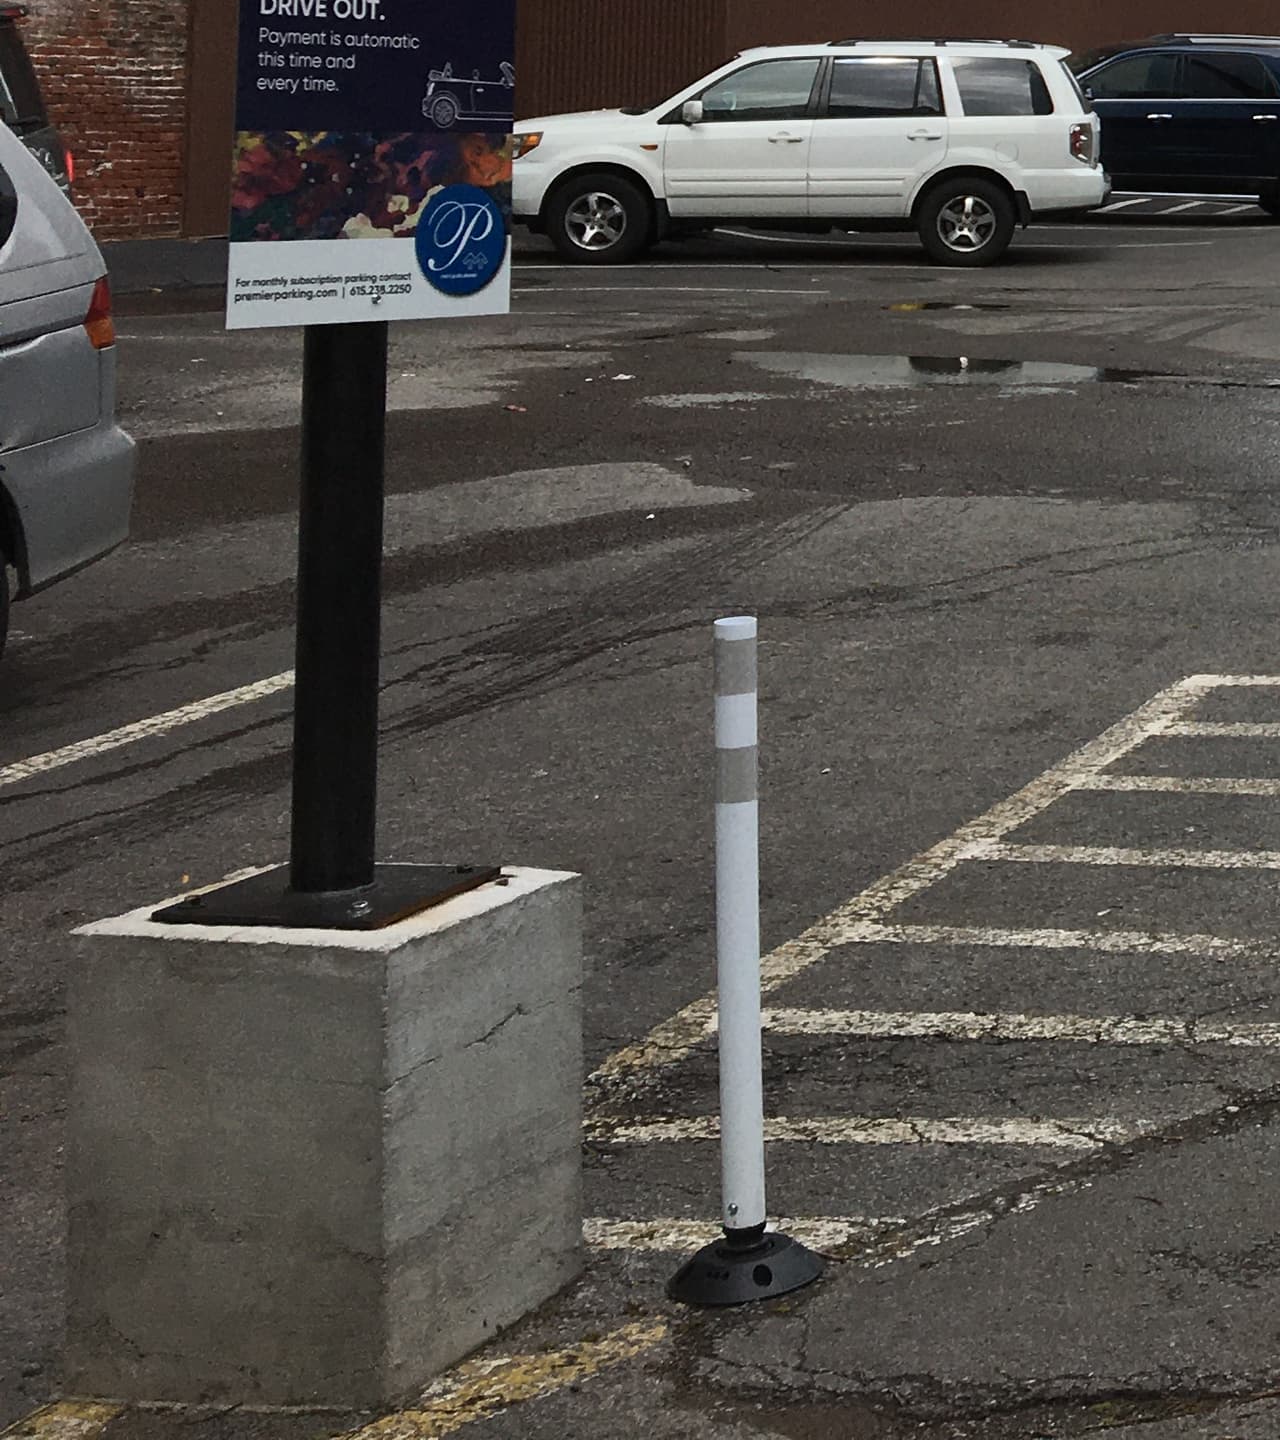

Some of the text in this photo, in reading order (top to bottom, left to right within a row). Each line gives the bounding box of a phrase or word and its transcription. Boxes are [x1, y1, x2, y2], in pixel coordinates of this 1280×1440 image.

[259, 27, 420, 49] Payment is automatic
[258, 53, 355, 70] this time and
[257, 75, 339, 94] every time.
[235, 272, 412, 288] For monthly subscription parking contact
[234, 288, 337, 304] premierparking.com
